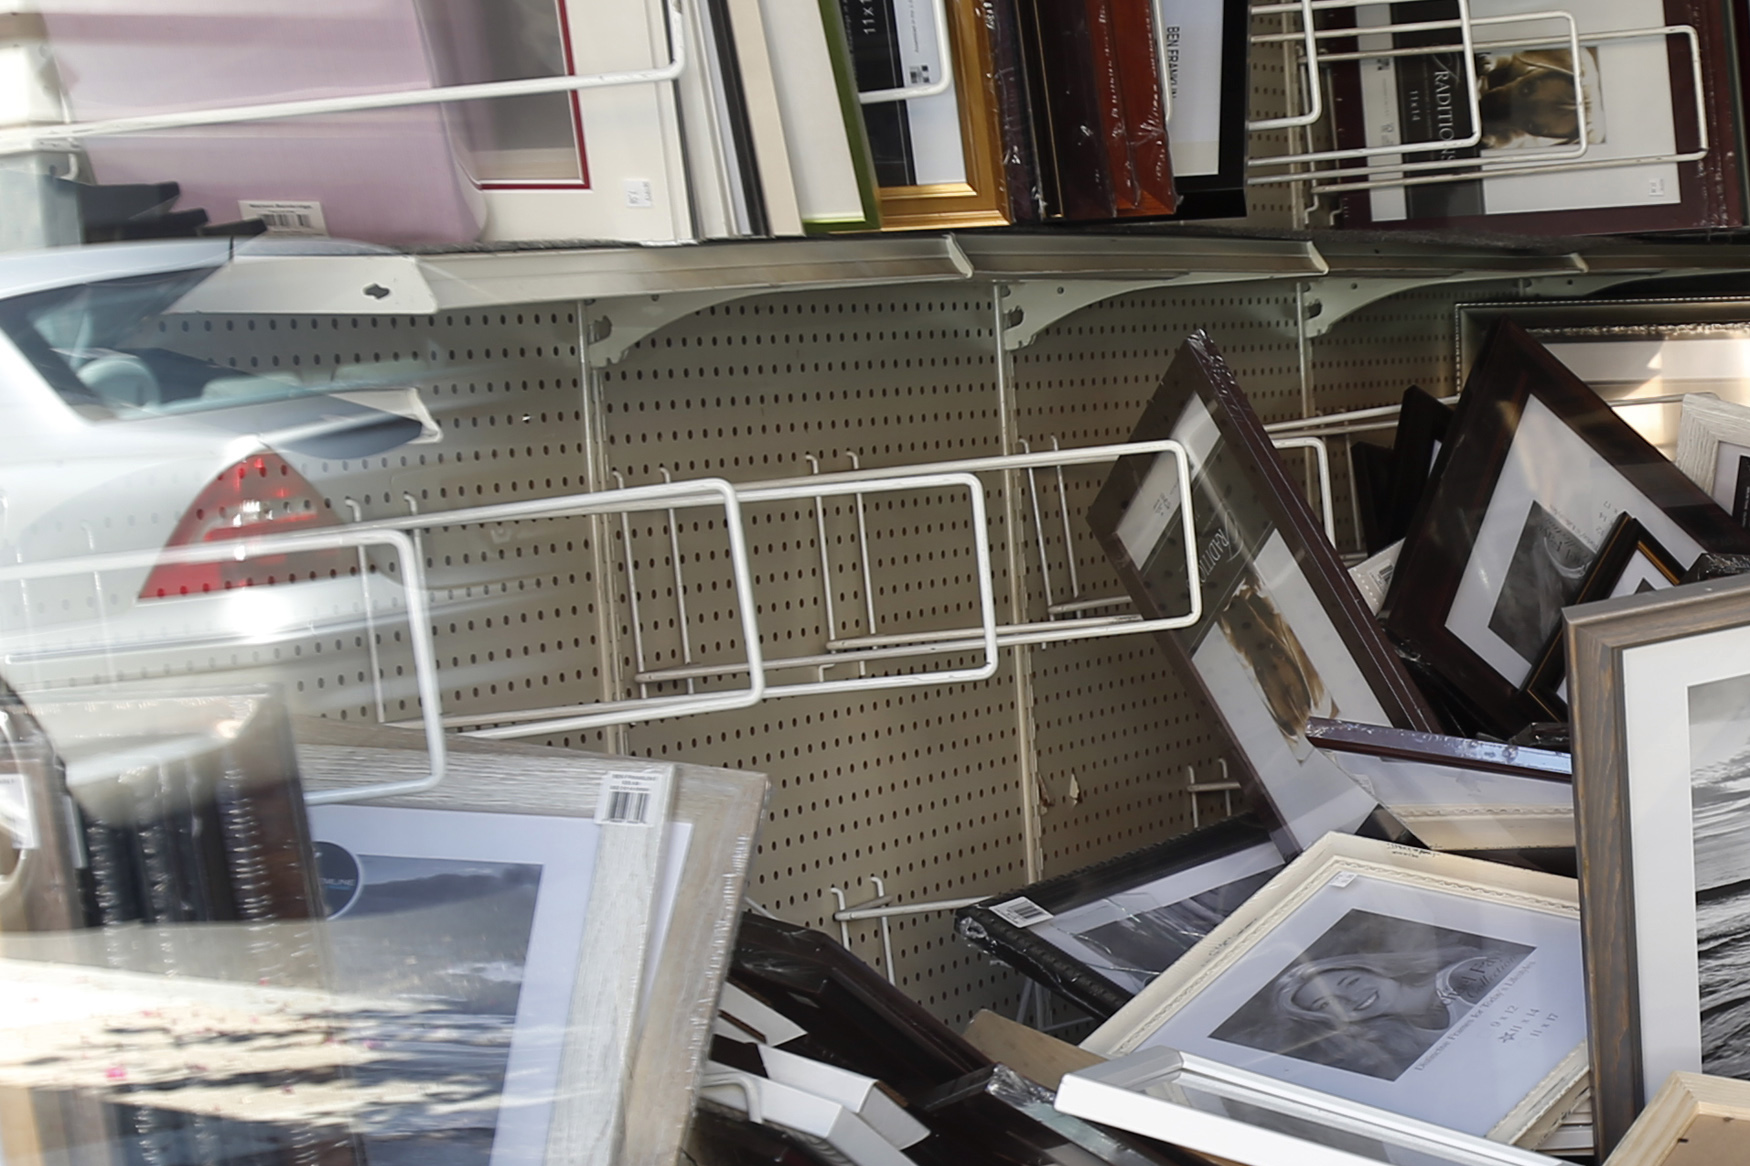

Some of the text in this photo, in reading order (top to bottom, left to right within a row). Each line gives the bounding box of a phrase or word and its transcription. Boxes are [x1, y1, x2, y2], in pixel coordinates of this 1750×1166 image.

[1166, 26, 1180, 47] BEN
[1409, 90, 1421, 121] 11x14
[1505, 1003, 1519, 1015] 12
[1526, 1006, 1541, 1019] 14
[1547, 1011, 1560, 1023] 17
